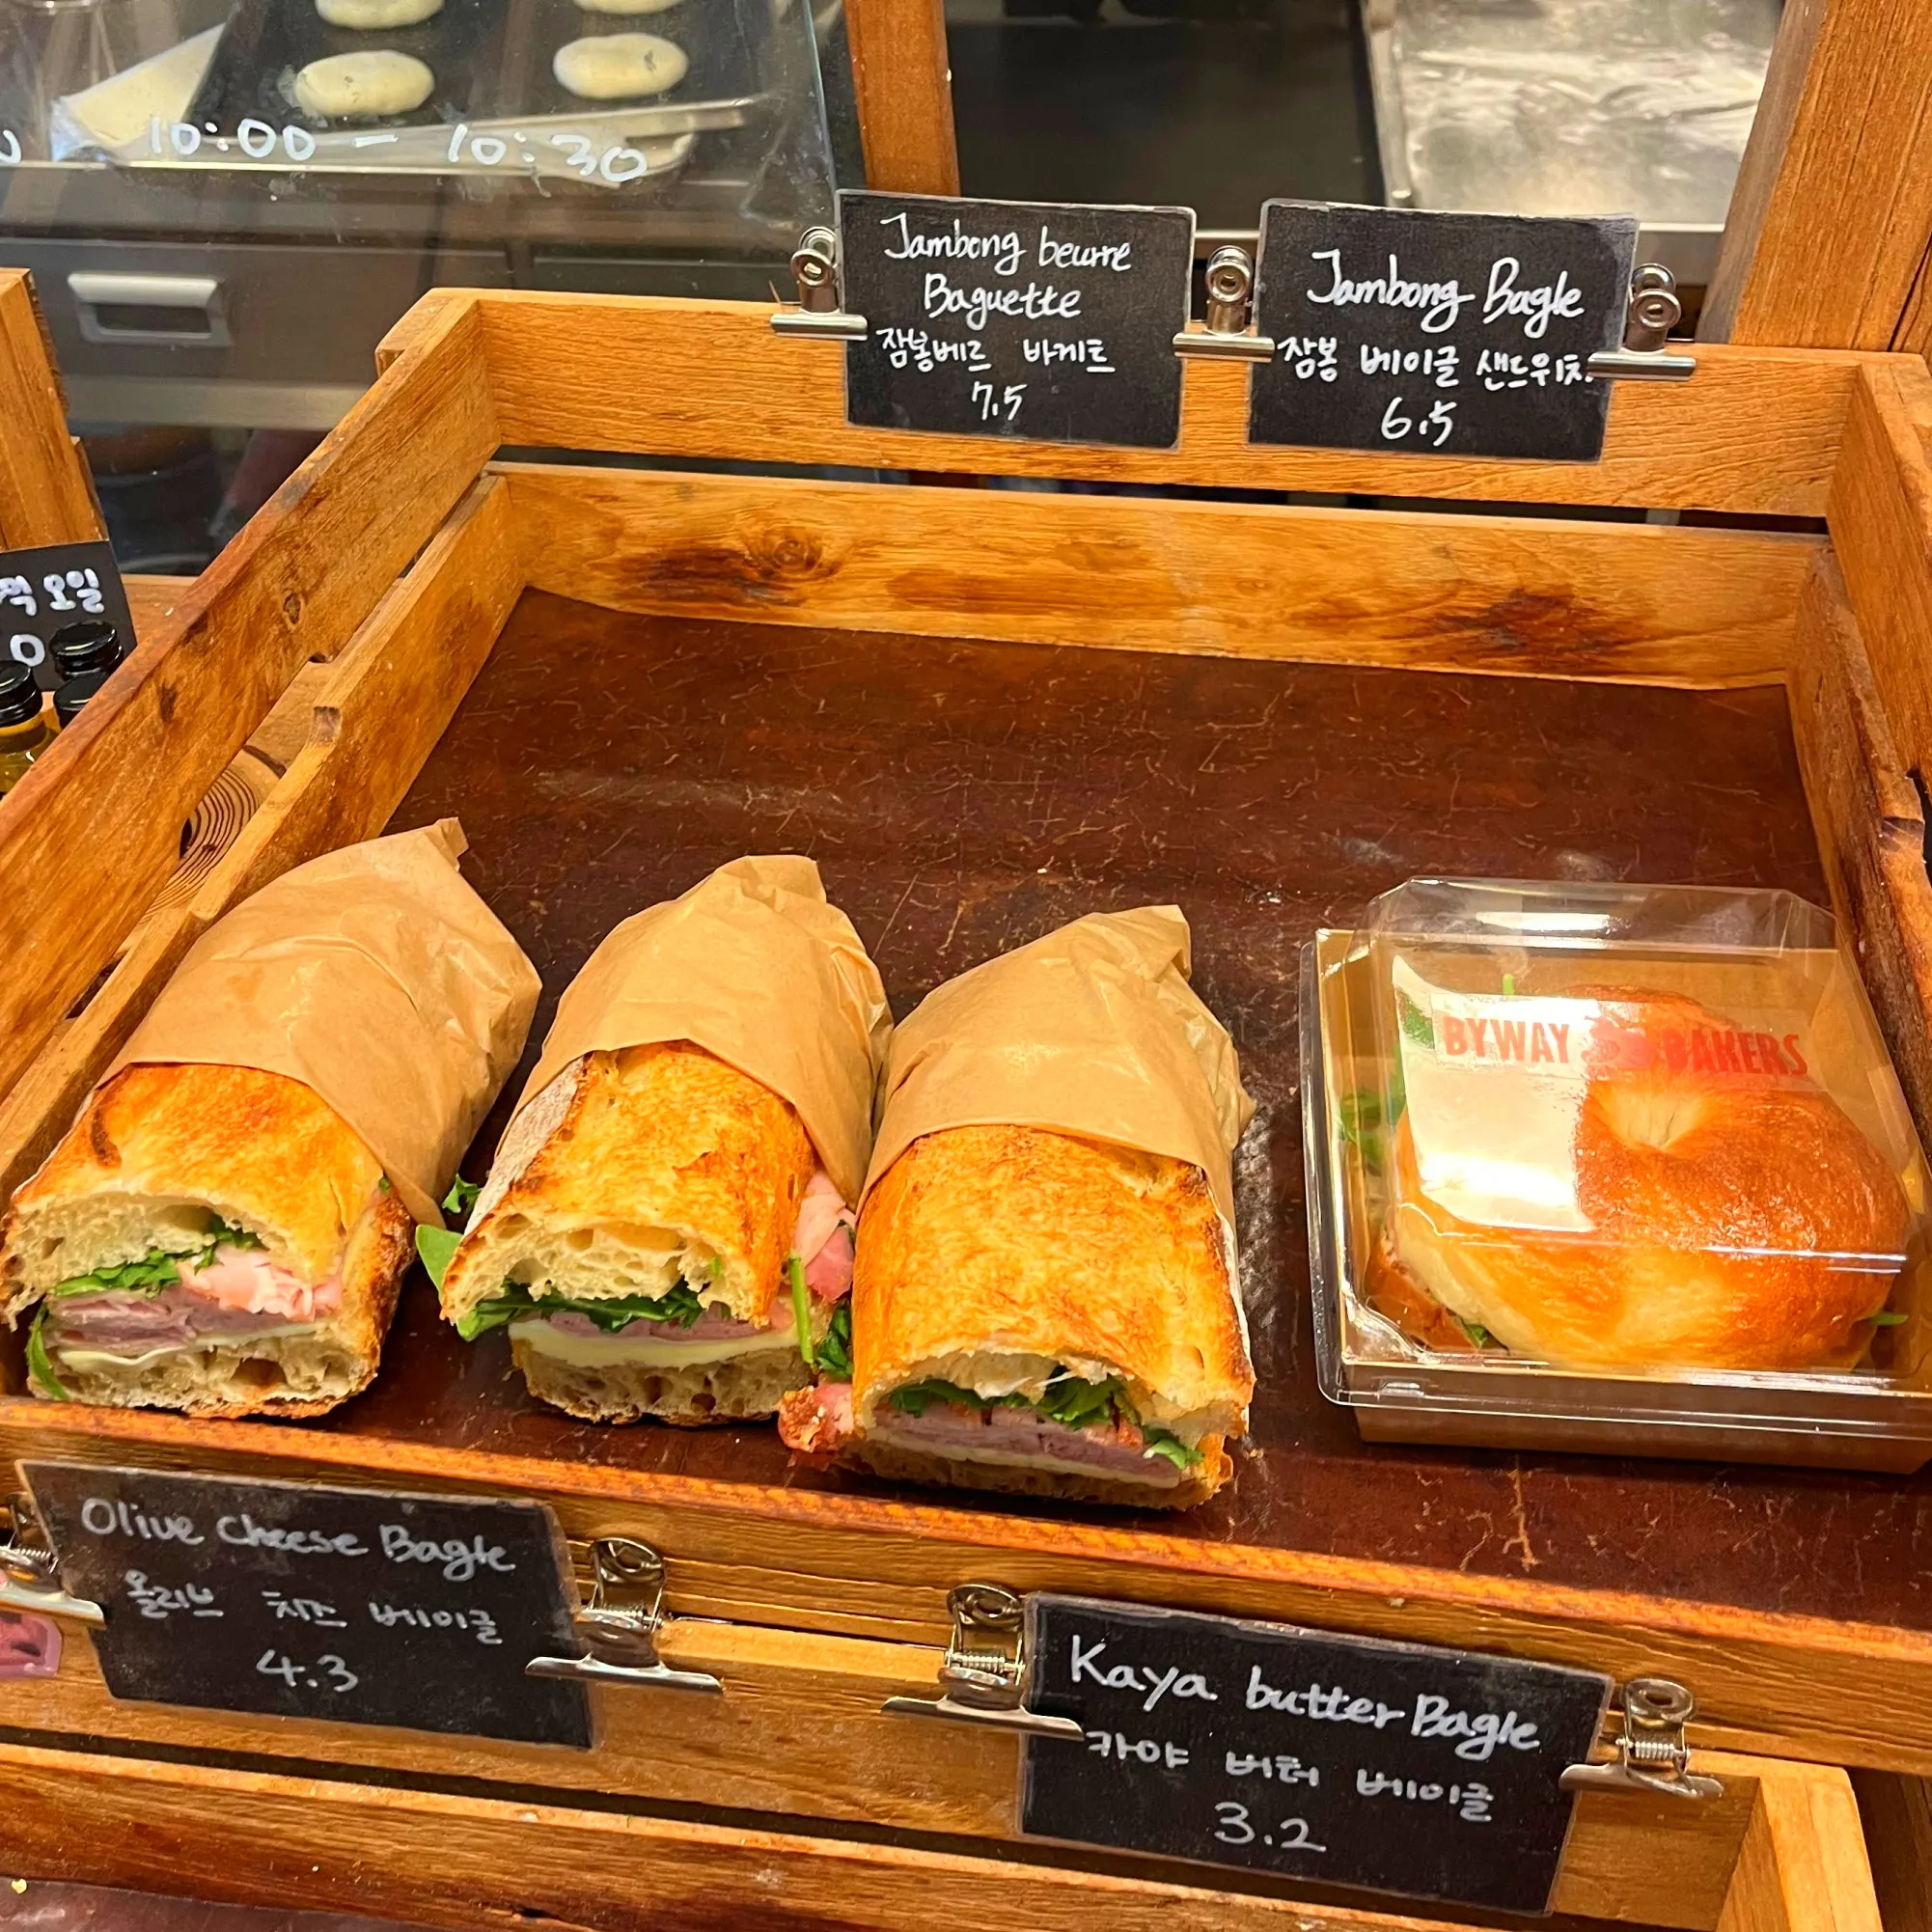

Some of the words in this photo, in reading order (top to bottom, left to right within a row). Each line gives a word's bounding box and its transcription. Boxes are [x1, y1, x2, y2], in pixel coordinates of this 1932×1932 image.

[150, 117, 317, 162] 10:00
[447, 124, 649, 183] 10:30
[879, 211, 1027, 276] Jambong
[1037, 225, 1132, 272] beurre
[924, 272, 1082, 331] Baguette
[1306, 248, 1477, 334] Jambong
[1481, 257, 1586, 340] Bagle
[875, 327, 992, 373] 잠봉베르
[1022, 338, 1117, 373] 바게트
[1276, 336, 1339, 383] 잠봉
[1360, 344, 1460, 388] 베이글
[1380, 397, 1458, 447] 6.5
[1443, 1015, 1570, 1064] BYWAY
[1664, 1027, 1808, 1077] BAKERS
[80, 1497, 205, 1547] Olive
[380, 1524, 516, 1582] Bagle
[124, 1569, 225, 1619] 올리브
[368, 1600, 504, 1645] 베이글
[255, 1648, 359, 1693] 4.3
[1069, 1635, 1218, 1712] Kaya
[1245, 1665, 1405, 1727] butter
[1413, 1694, 1541, 1761] Bagle
[1086, 1729, 1190, 1768] 가야
[1226, 1751, 1320, 1787] 버터
[1356, 1768, 1495, 1823] 베이글
[1213, 1801, 1328, 1852] 3.2
